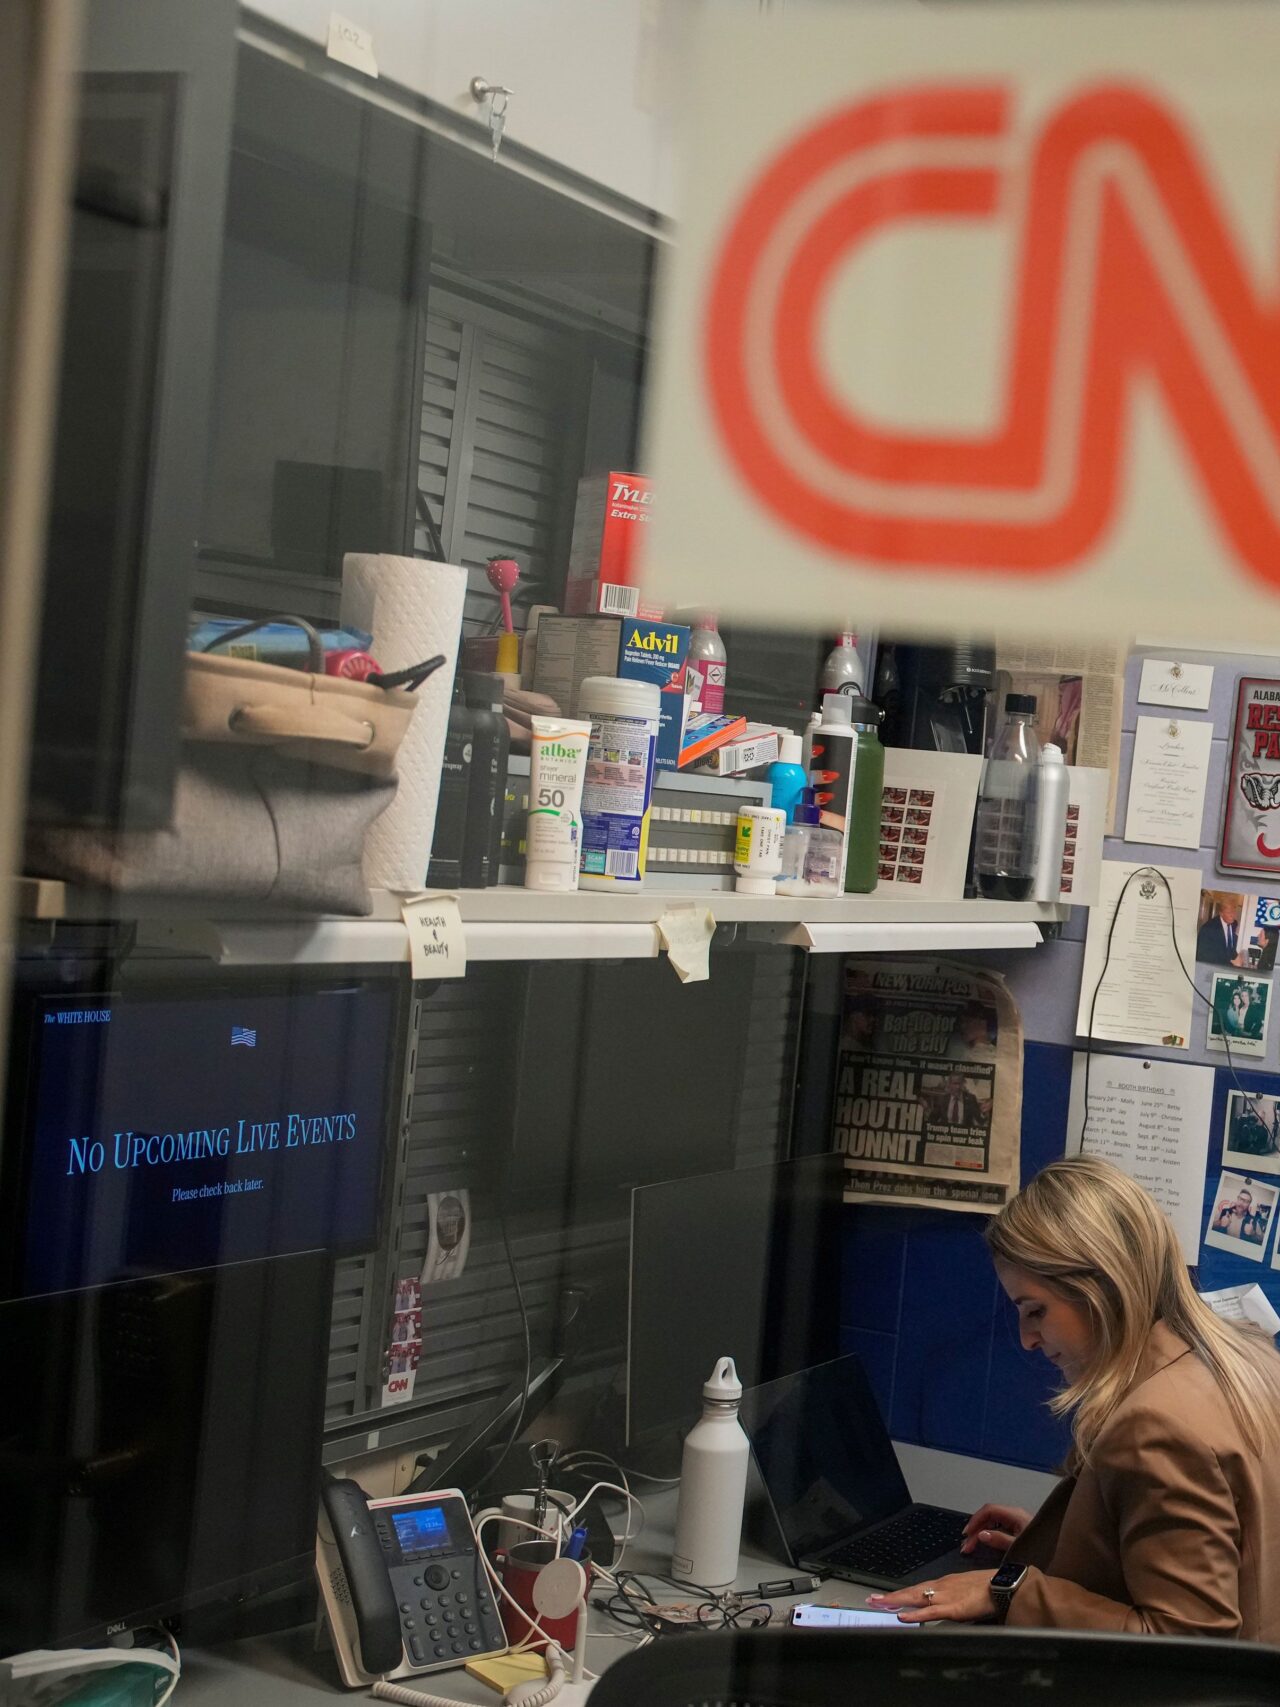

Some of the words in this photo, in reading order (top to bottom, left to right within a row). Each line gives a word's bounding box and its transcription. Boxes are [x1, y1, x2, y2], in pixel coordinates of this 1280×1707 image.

[612, 483, 657, 505] TYLE
[611, 509, 636, 521] Extra
[626, 628, 679, 654] Advil
[540, 743, 577, 759] alba
[539, 772, 577, 784] mineral
[538, 789, 564, 807] 50
[420, 916, 447, 929] HEALTH
[423, 943, 449, 959] BEAUTY
[57, 1011, 83, 1024] WHITE
[84, 1010, 111, 1023] HOUSE
[839, 1066, 855, 1094] A
[861, 1068, 917, 1100] REAL
[1087, 1094, 1106, 1102] anuary
[835, 1096, 924, 1132] HOUTHI
[926, 1122, 949, 1134] Trump
[833, 1126, 922, 1163] DUNNIT
[172, 1187, 198, 1202] Please
[199, 1183, 223, 1199] check
[224, 1180, 243, 1196] back
[244, 1178, 264, 1194] later.
[388, 1378, 409, 1393] CNN
[107, 1621, 127, 1636] DELL
